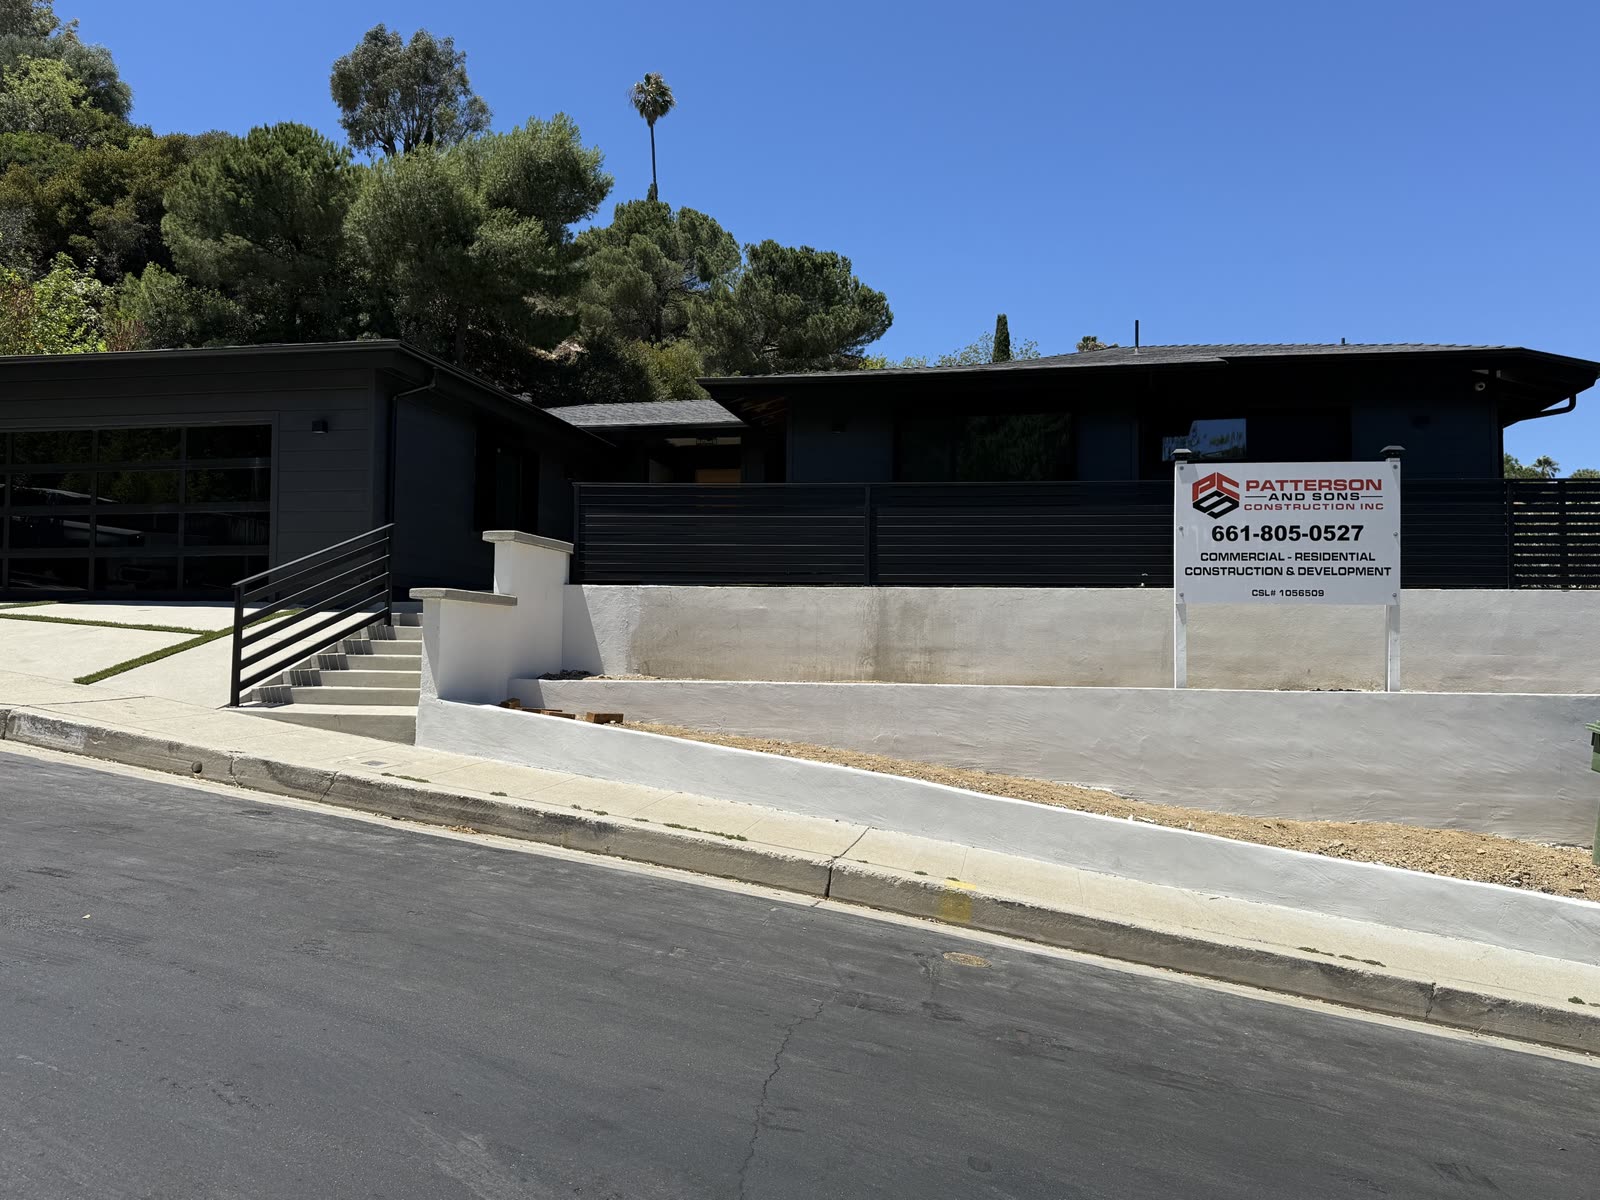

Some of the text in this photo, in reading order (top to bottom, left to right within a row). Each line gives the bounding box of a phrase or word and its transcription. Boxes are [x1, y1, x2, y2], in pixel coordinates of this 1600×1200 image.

[1245, 479, 1382, 492] PATTERSON
[1268, 492, 1360, 501] AND SONS
[1244, 503, 1354, 511] CONSTRUCTION
[1211, 525, 1364, 542] 661-805-0527
[1200, 552, 1285, 562] COMMERCIAL
[1295, 552, 1375, 562] RESIDENTIAL
[1184, 566, 1392, 576] CONSTRUCTION & DEVELOPMENT
[1251, 589, 1325, 597] CSL# 1056509
